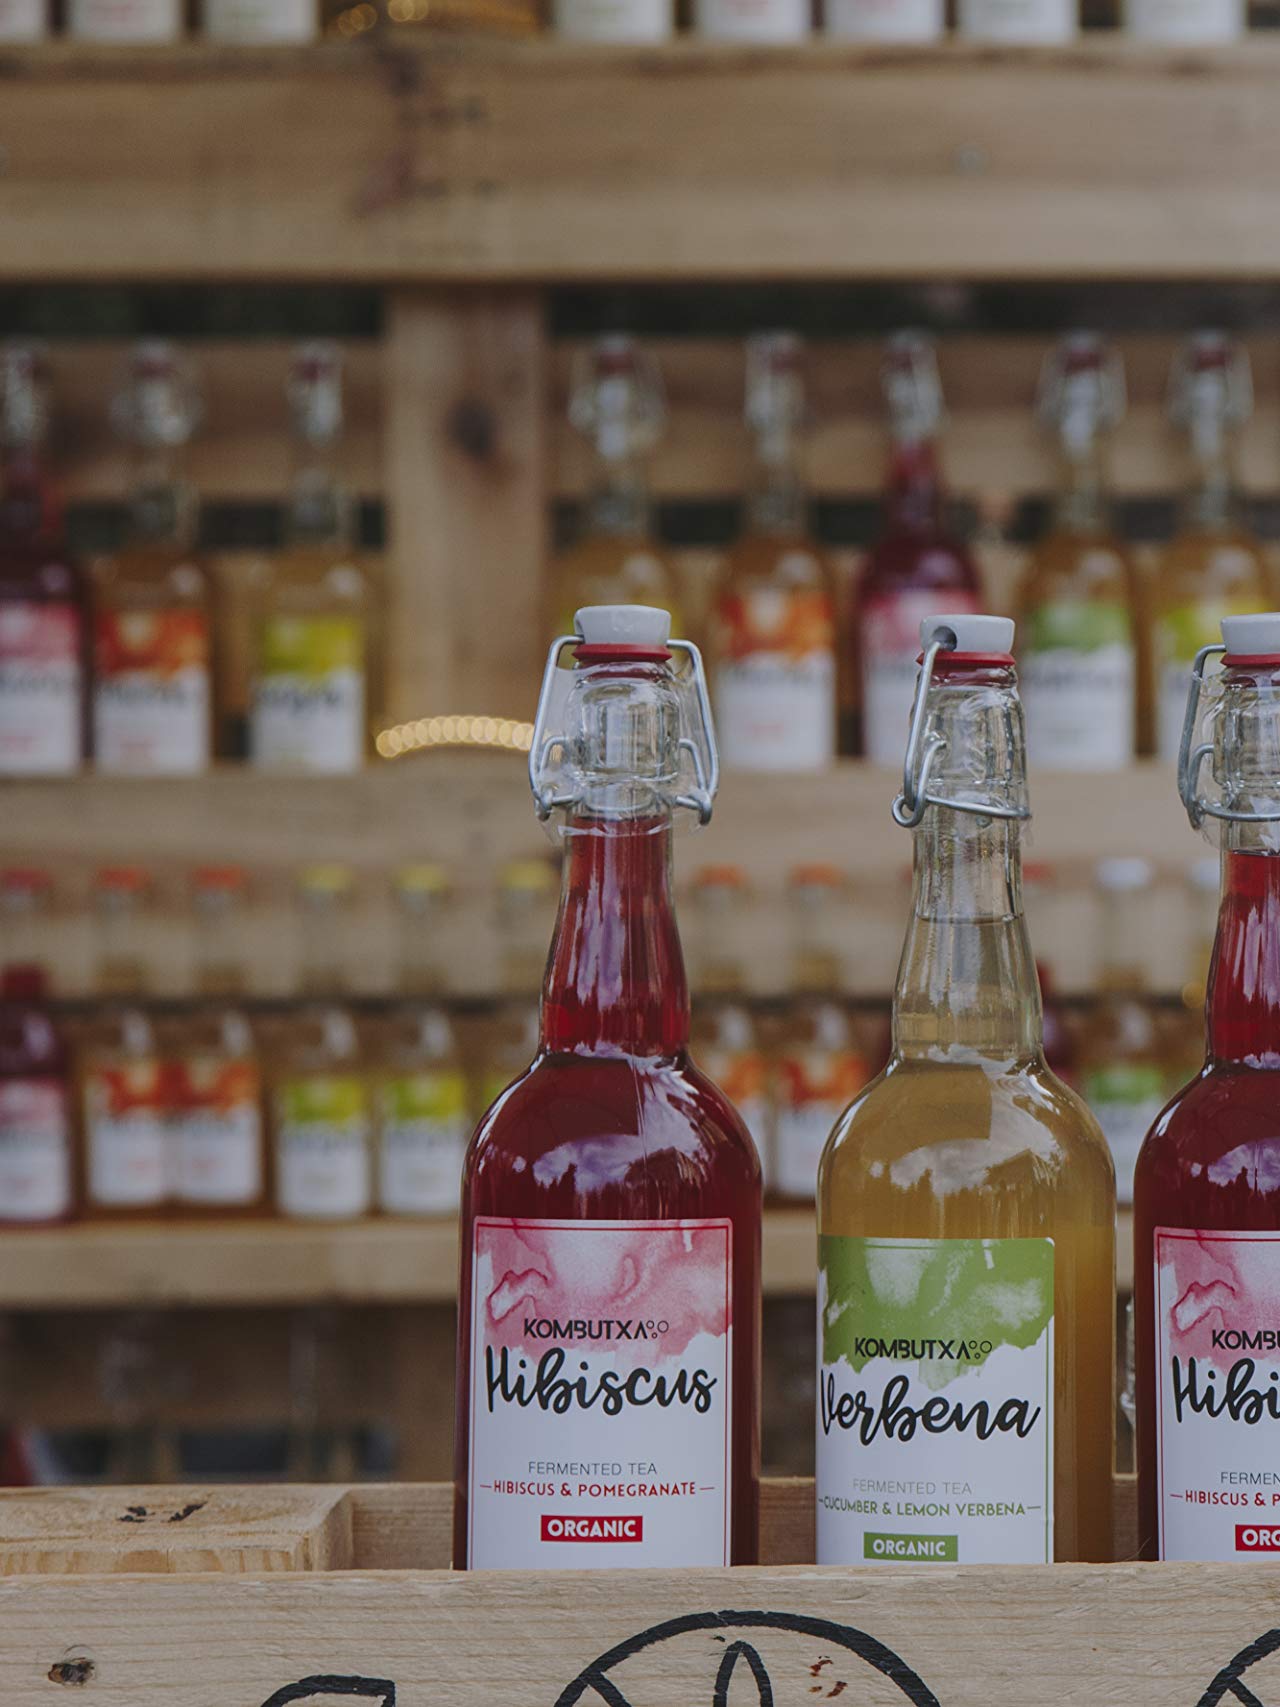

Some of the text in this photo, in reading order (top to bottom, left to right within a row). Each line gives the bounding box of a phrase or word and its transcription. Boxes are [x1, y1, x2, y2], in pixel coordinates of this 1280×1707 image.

[523, 1318, 648, 1339] KOMBUTXA
[854, 1337, 971, 1360] KOMBUTXA
[485, 1345, 718, 1415] Hibiscus
[820, 1369, 1042, 1446] Verbena
[527, 1461, 658, 1477] FERMENTED TEA
[493, 1481, 697, 1498] HIBISCUS & POMEGRANATE
[852, 1478, 973, 1495] FERMENTED TEA
[823, 1495, 1026, 1517] CUCUMBER & LEMON VERBENA
[1184, 1489, 1249, 1506] HIBISCUS
[1253, 1491, 1267, 1507] &
[547, 1518, 638, 1539] ORGANIC
[872, 1538, 947, 1557] ORGANIC
